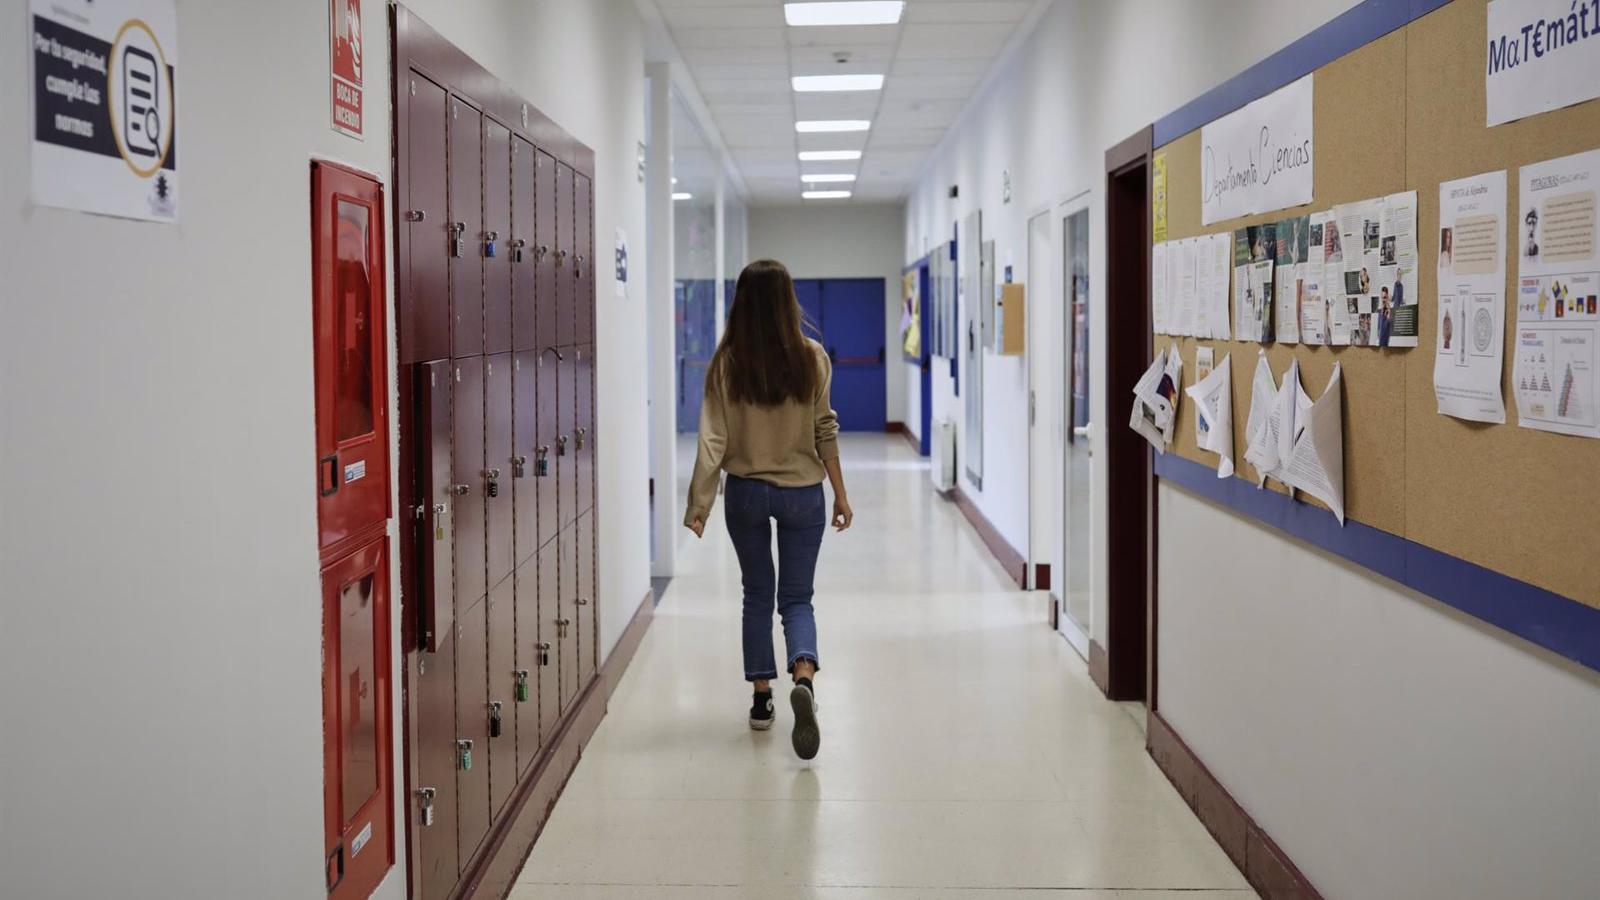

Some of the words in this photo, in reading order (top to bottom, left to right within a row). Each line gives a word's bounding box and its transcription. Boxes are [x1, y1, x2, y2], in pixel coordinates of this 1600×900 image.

[46, 74, 83, 103] cumple
[336, 82, 351, 105] BOCA
[351, 89, 359, 108] DE
[335, 104, 360, 130] INCENDIO
[1204, 145, 1257, 207] Departamento
[1259, 125, 1309, 185] Ciencias
